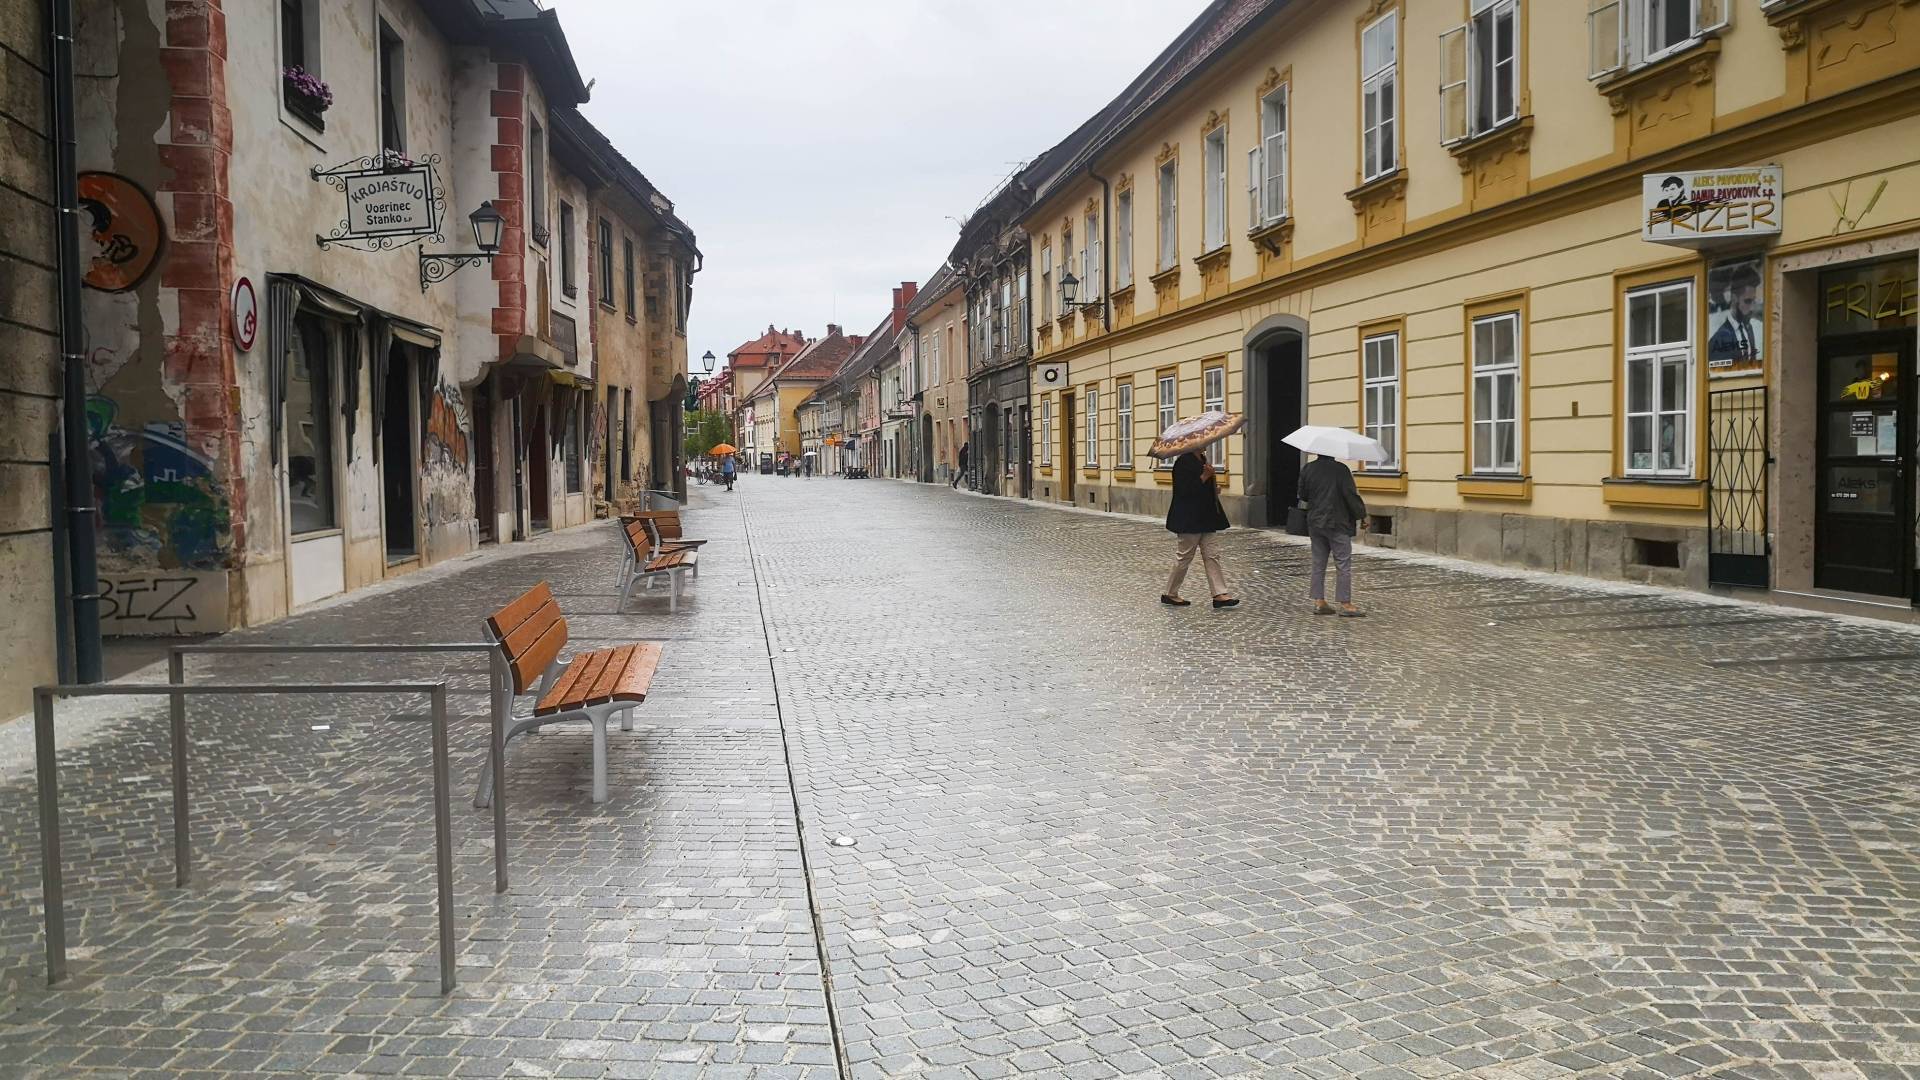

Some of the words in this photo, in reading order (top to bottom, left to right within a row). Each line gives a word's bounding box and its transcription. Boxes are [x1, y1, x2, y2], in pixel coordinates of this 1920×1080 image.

[1691, 189, 1715, 201] DAMIR
[366, 214, 402, 225] Stanko
[1648, 200, 1777, 234] FRIZER
